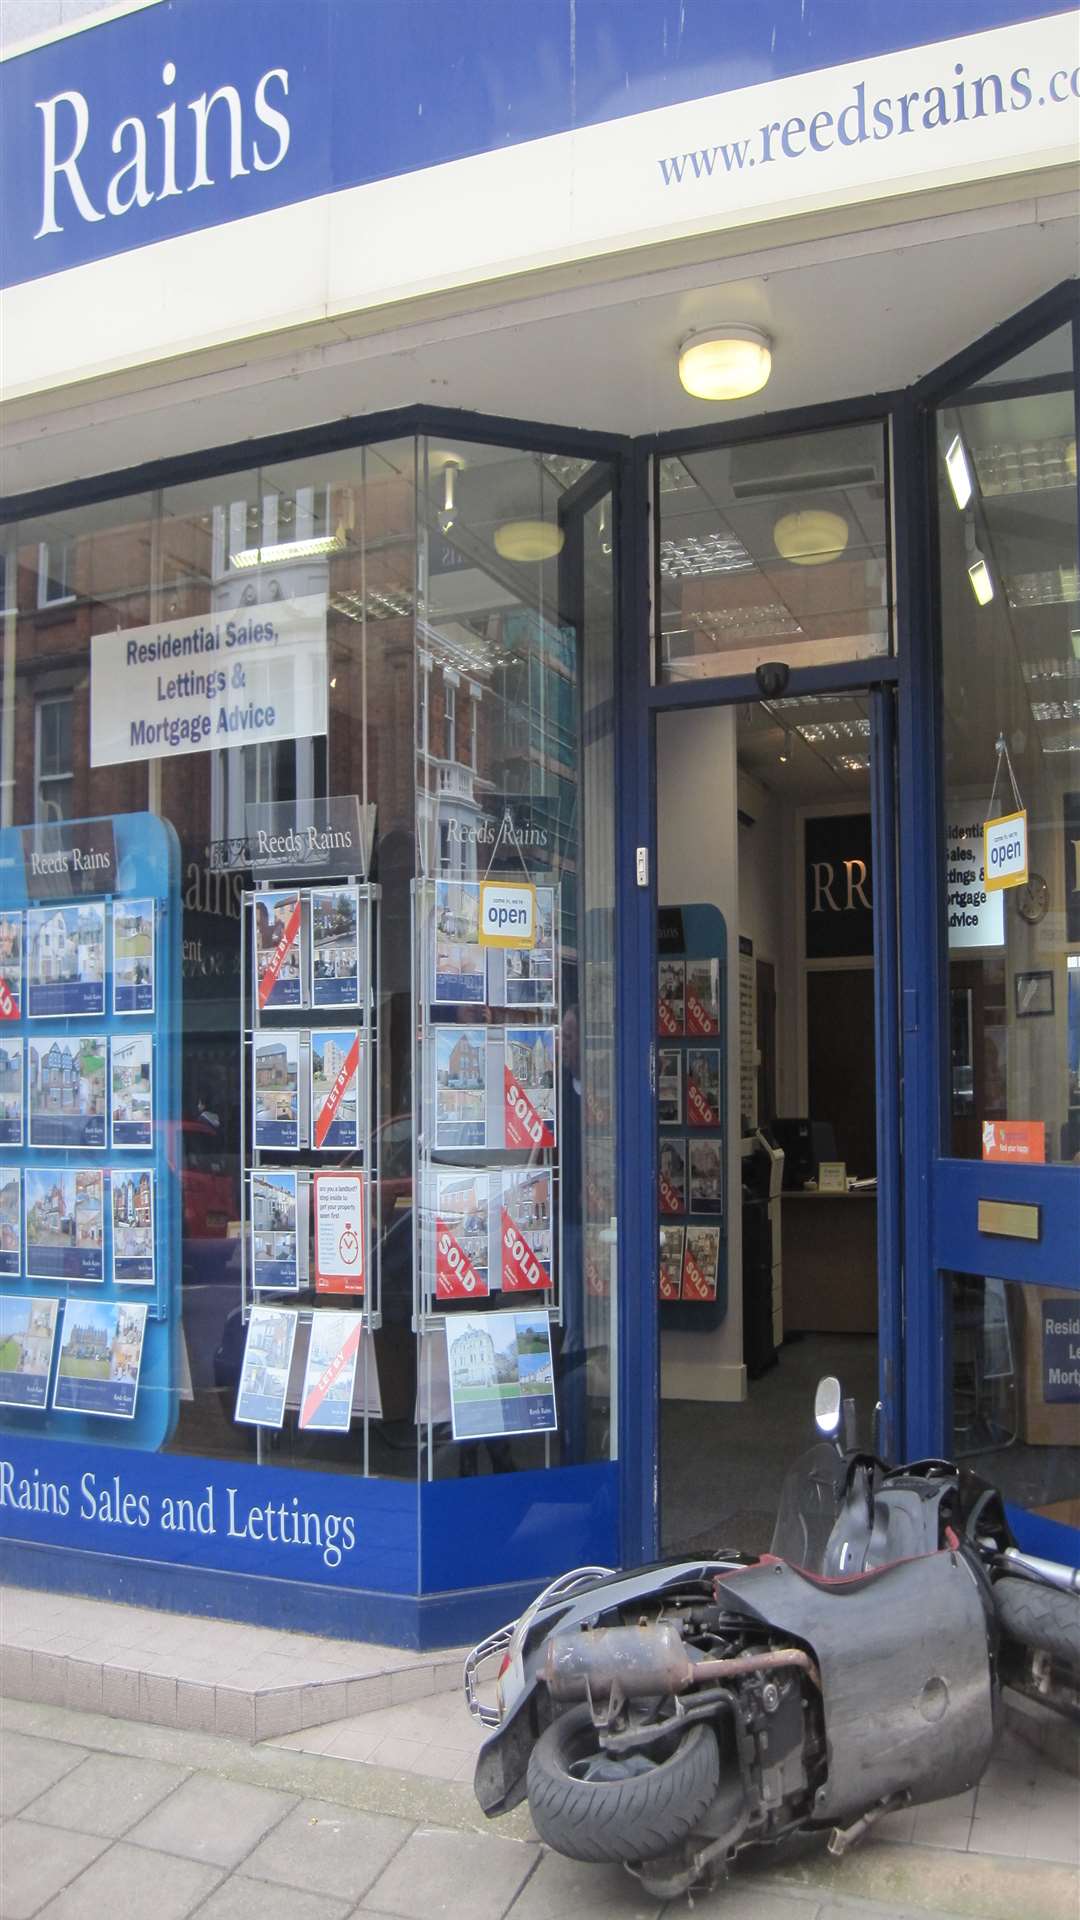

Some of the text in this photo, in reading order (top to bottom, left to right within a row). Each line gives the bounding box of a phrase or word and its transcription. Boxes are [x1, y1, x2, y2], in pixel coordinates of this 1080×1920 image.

[33, 62, 291, 240] Rains
[127, 618, 279, 665] Residential Sales,
[157, 662, 246, 701] Lettings &
[130, 703, 275, 747] Mortgage Advice
[257, 825, 352, 855] Reeds Rains
[446, 818, 548, 846] Reeds Rains
[31, 848, 110, 876] Reeds Rains
[991, 841, 1021, 868] open
[183, 862, 242, 920] ains
[488, 907, 527, 927] open
[948, 912, 979, 927] dvice
[687, 997, 712, 1033] SOLD
[327, 1065, 350, 1109] LET BY
[688, 1086, 712, 1123] SOLD
[507, 1085, 543, 1143] SOLD
[439, 1233, 476, 1292] SOLD
[504, 1227, 540, 1285] SOLD
[686, 1262, 709, 1298] SOLD
[0, 1460, 356, 1567] Rains Sales and Lettings
